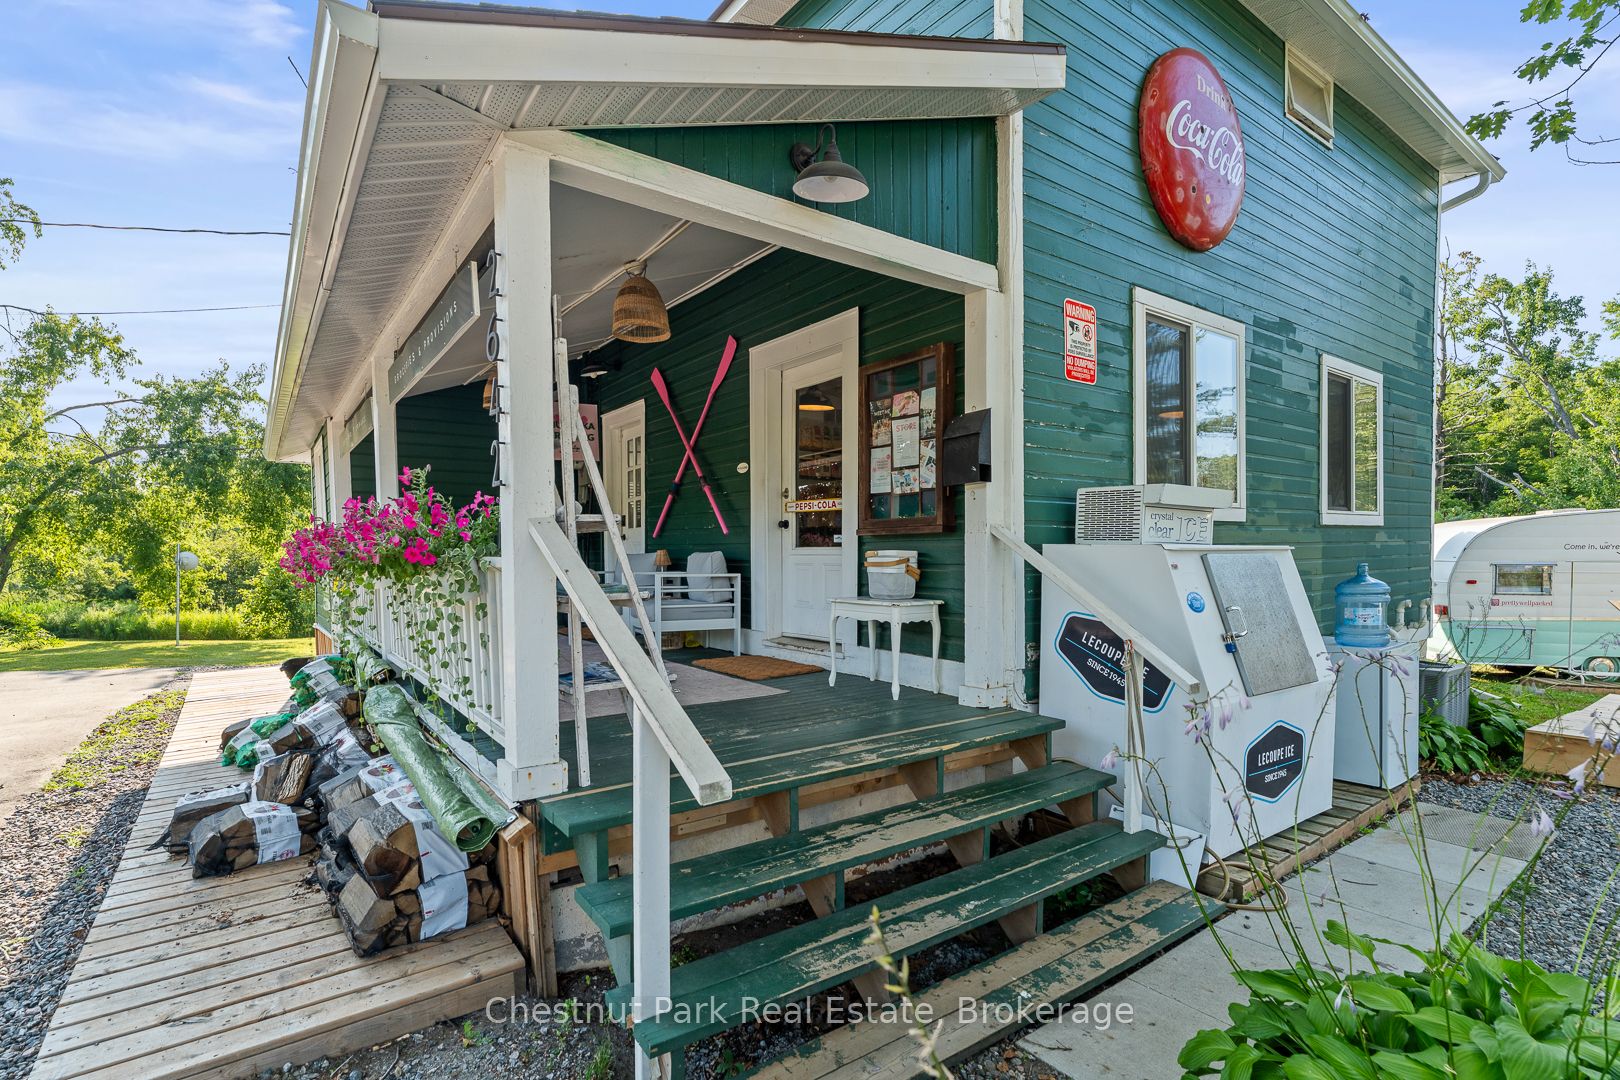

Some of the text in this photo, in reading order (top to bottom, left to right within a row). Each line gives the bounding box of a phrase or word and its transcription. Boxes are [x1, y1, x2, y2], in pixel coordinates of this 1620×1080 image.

[1196, 74, 1228, 111] Drink
[1066, 302, 1095, 322] WARNING
[423, 300, 458, 350] PROVISIONS
[1075, 357, 1095, 369] DUMPING
[1149, 516, 1209, 542] clear ICE
[1151, 512, 1174, 523] crystal
[1086, 658, 1110, 677] SINCE
[1109, 672, 1125, 687] 1945
[1285, 744, 1295, 759] ICE
